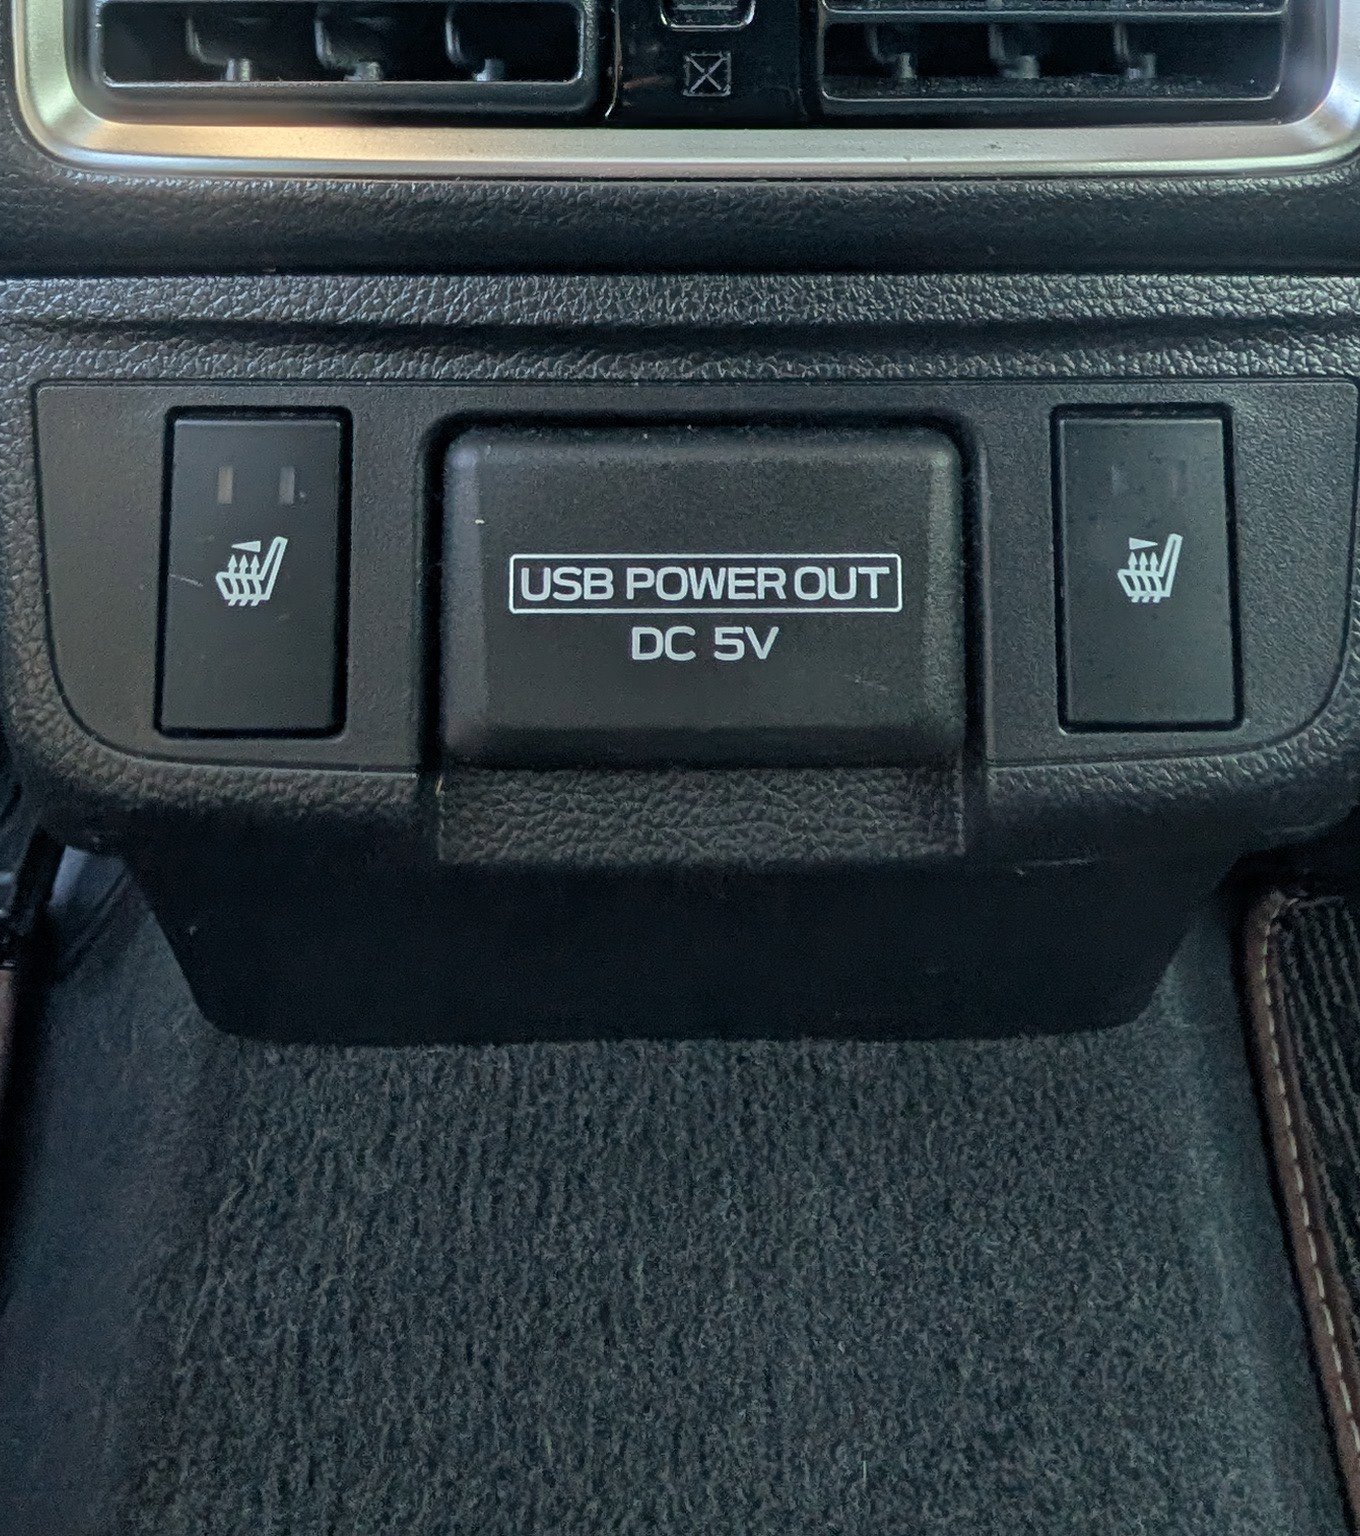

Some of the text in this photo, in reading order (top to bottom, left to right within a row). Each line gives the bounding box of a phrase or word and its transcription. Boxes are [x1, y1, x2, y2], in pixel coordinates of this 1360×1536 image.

[520, 565, 891, 601] USB POWER OUT
[631, 626, 780, 661] DC 5V
